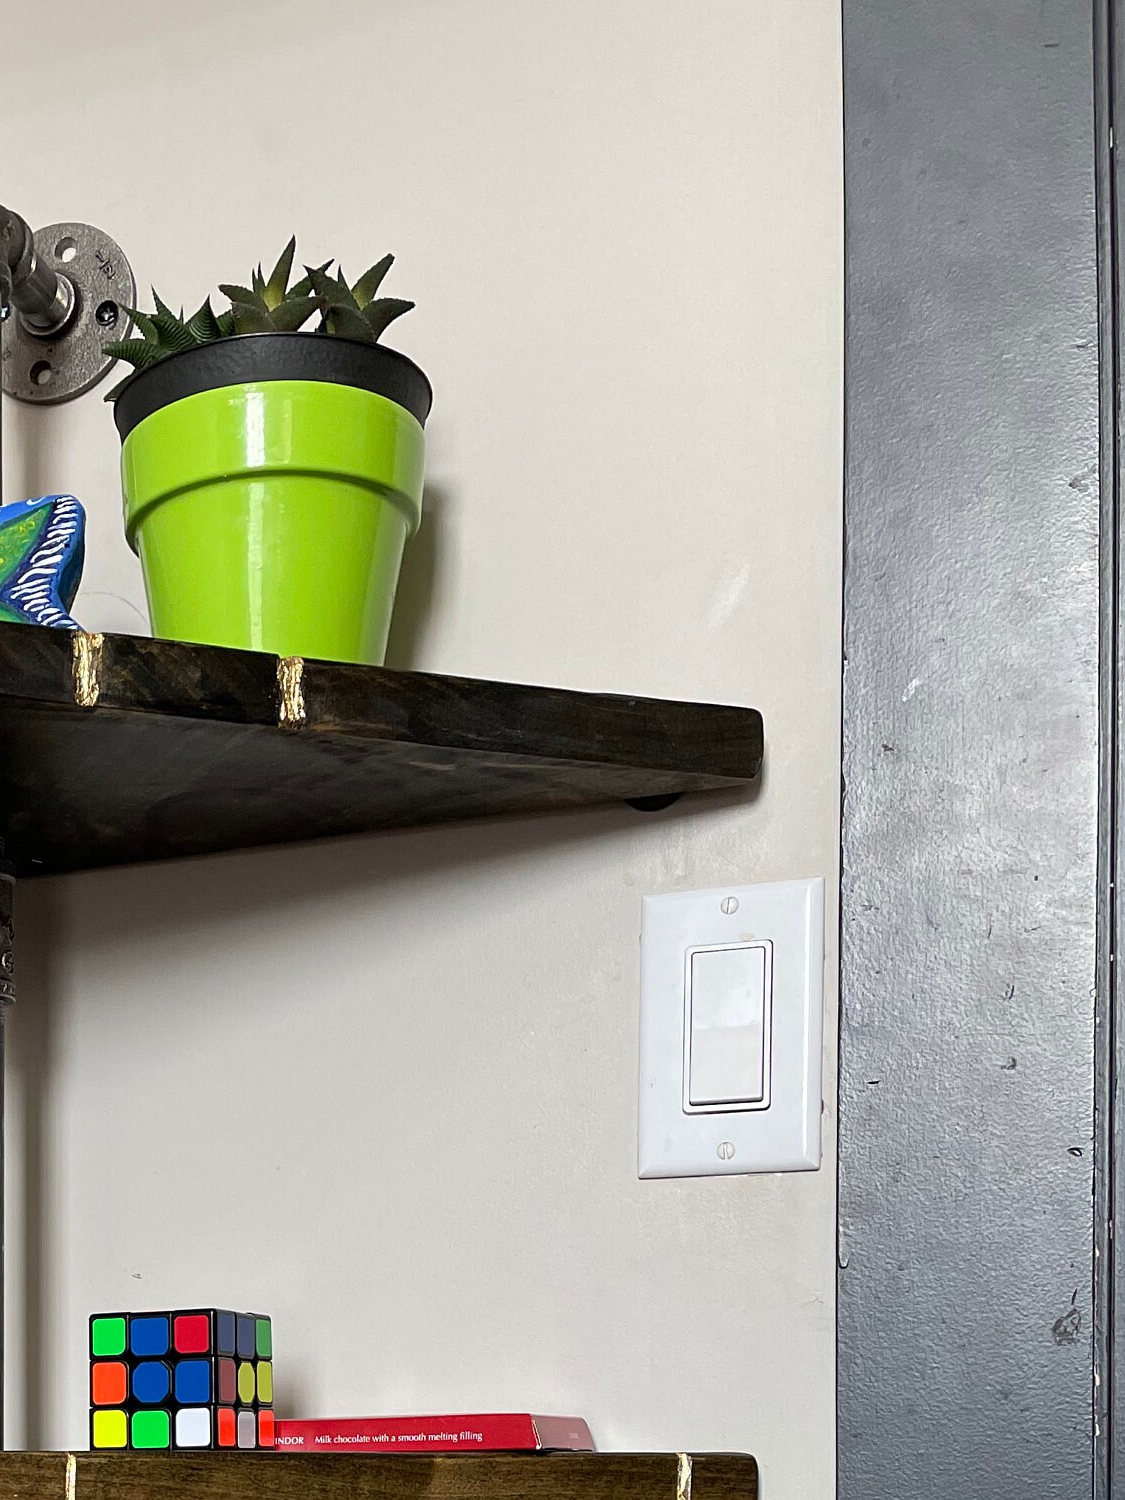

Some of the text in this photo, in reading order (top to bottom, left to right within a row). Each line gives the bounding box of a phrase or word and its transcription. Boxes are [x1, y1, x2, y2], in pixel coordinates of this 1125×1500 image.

[275, 1436, 304, 1445] INDOR
[315, 1435, 331, 1444] Milk
[334, 1434, 371, 1444] chocolate
[372, 1433, 389, 1442] with
[397, 1432, 426, 1442] smooth
[428, 1431, 458, 1442] melting
[459, 1431, 483, 1442] filling
